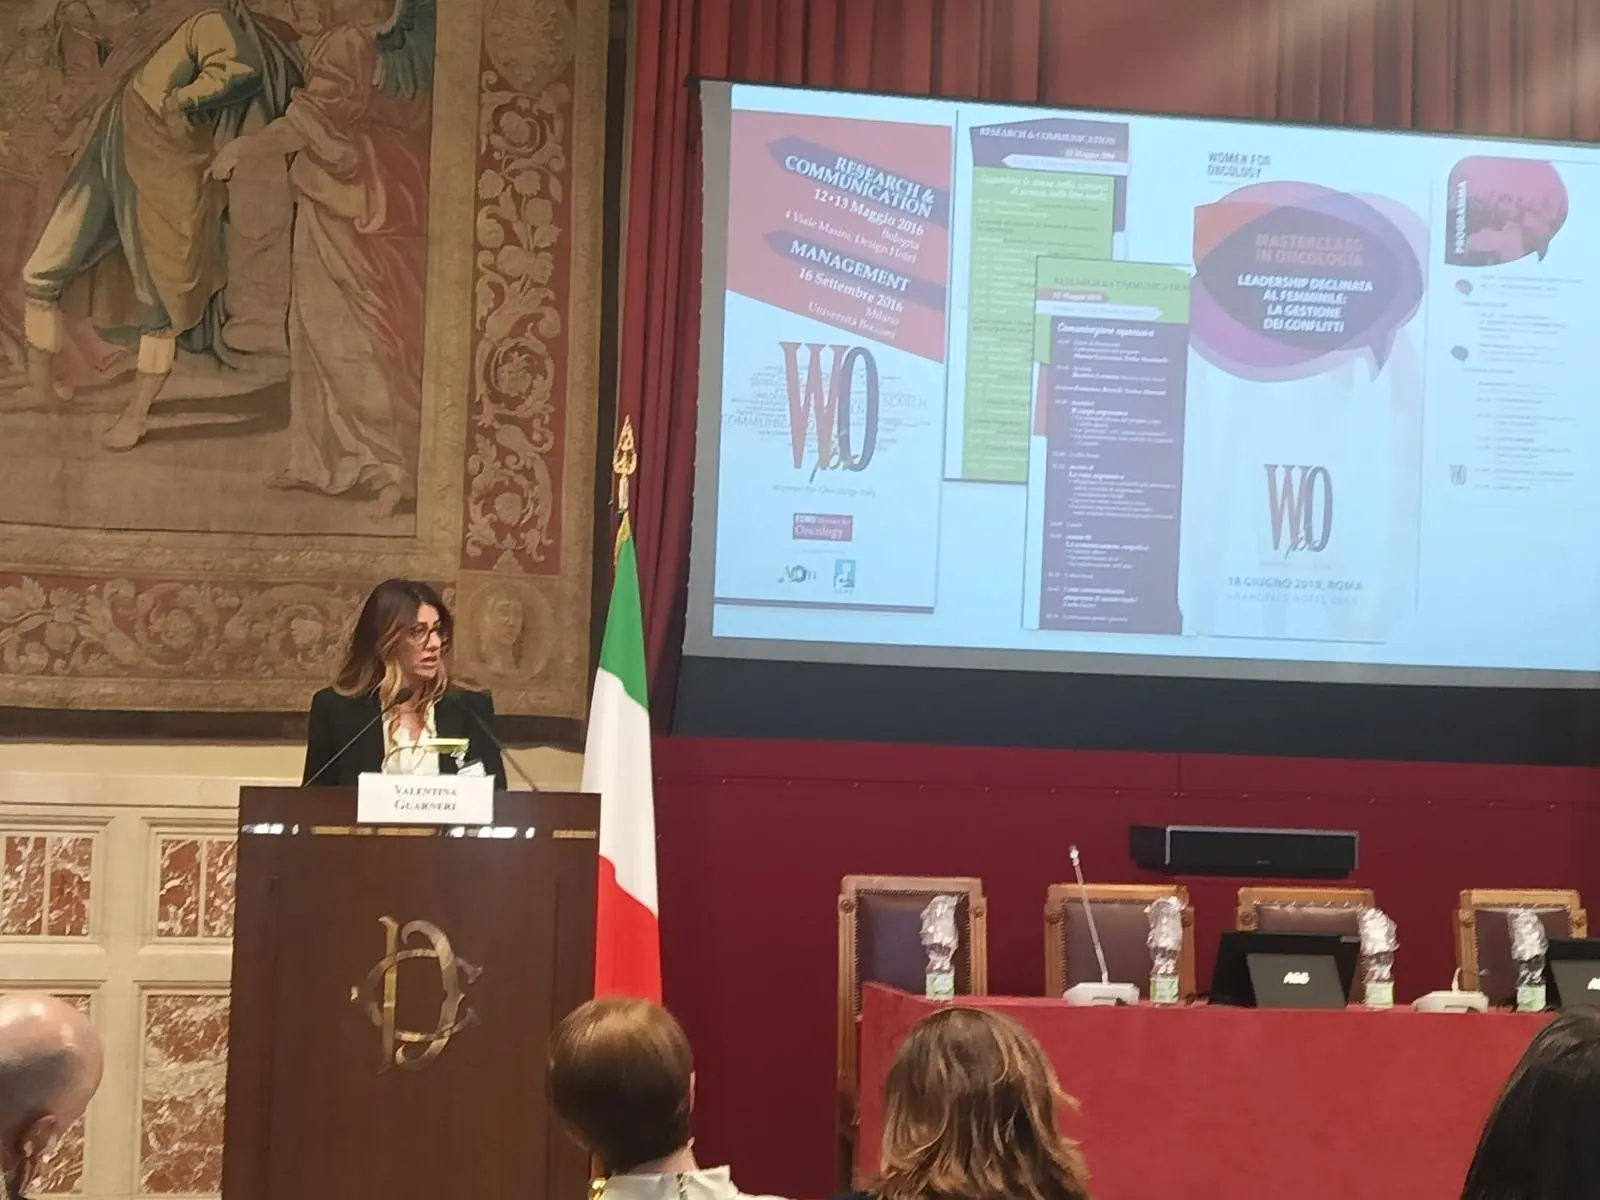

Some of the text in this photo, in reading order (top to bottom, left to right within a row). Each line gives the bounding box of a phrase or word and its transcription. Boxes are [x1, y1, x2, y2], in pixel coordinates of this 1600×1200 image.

[785, 155, 933, 218] COMMUNICATION
[835, 156, 935, 204] RESEARCH &
[850, 200, 896, 227] Maggio
[897, 218, 925, 236] 2016
[1256, 233, 1362, 251] MASTERCLASS
[790, 240, 911, 291] MANAGEMENT
[1257, 248, 1363, 267] IN ONCOLOGIA
[799, 267, 904, 313] 16 Settembre 2016
[1237, 273, 1309, 289] LEADERSHIP
[1267, 303, 1343, 318] LA GESTIONE
[1263, 317, 1345, 333] DEI CONFLITTI
